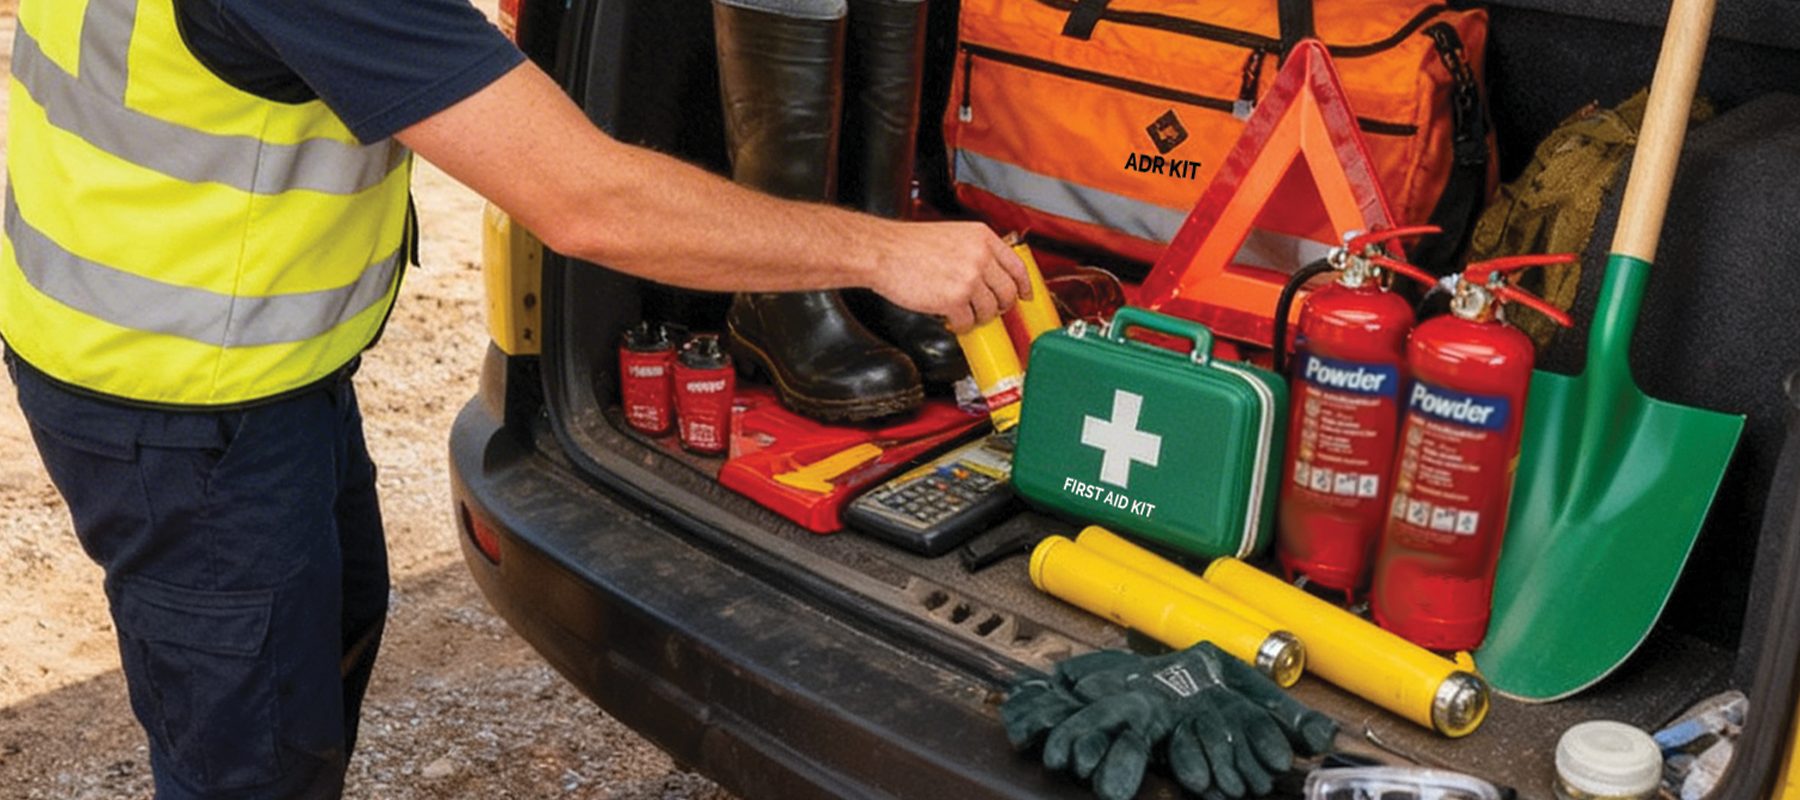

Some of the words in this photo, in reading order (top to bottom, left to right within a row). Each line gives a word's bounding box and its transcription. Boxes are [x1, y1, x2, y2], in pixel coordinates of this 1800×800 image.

[1124, 152, 1165, 175] ADR
[1169, 159, 1202, 180] KIT
[1305, 356, 1386, 391] Powder
[1410, 381, 1494, 425] Powder
[1063, 476, 1105, 501] FIRST
[1103, 490, 1129, 510] AID
[1130, 499, 1156, 518] KIT
